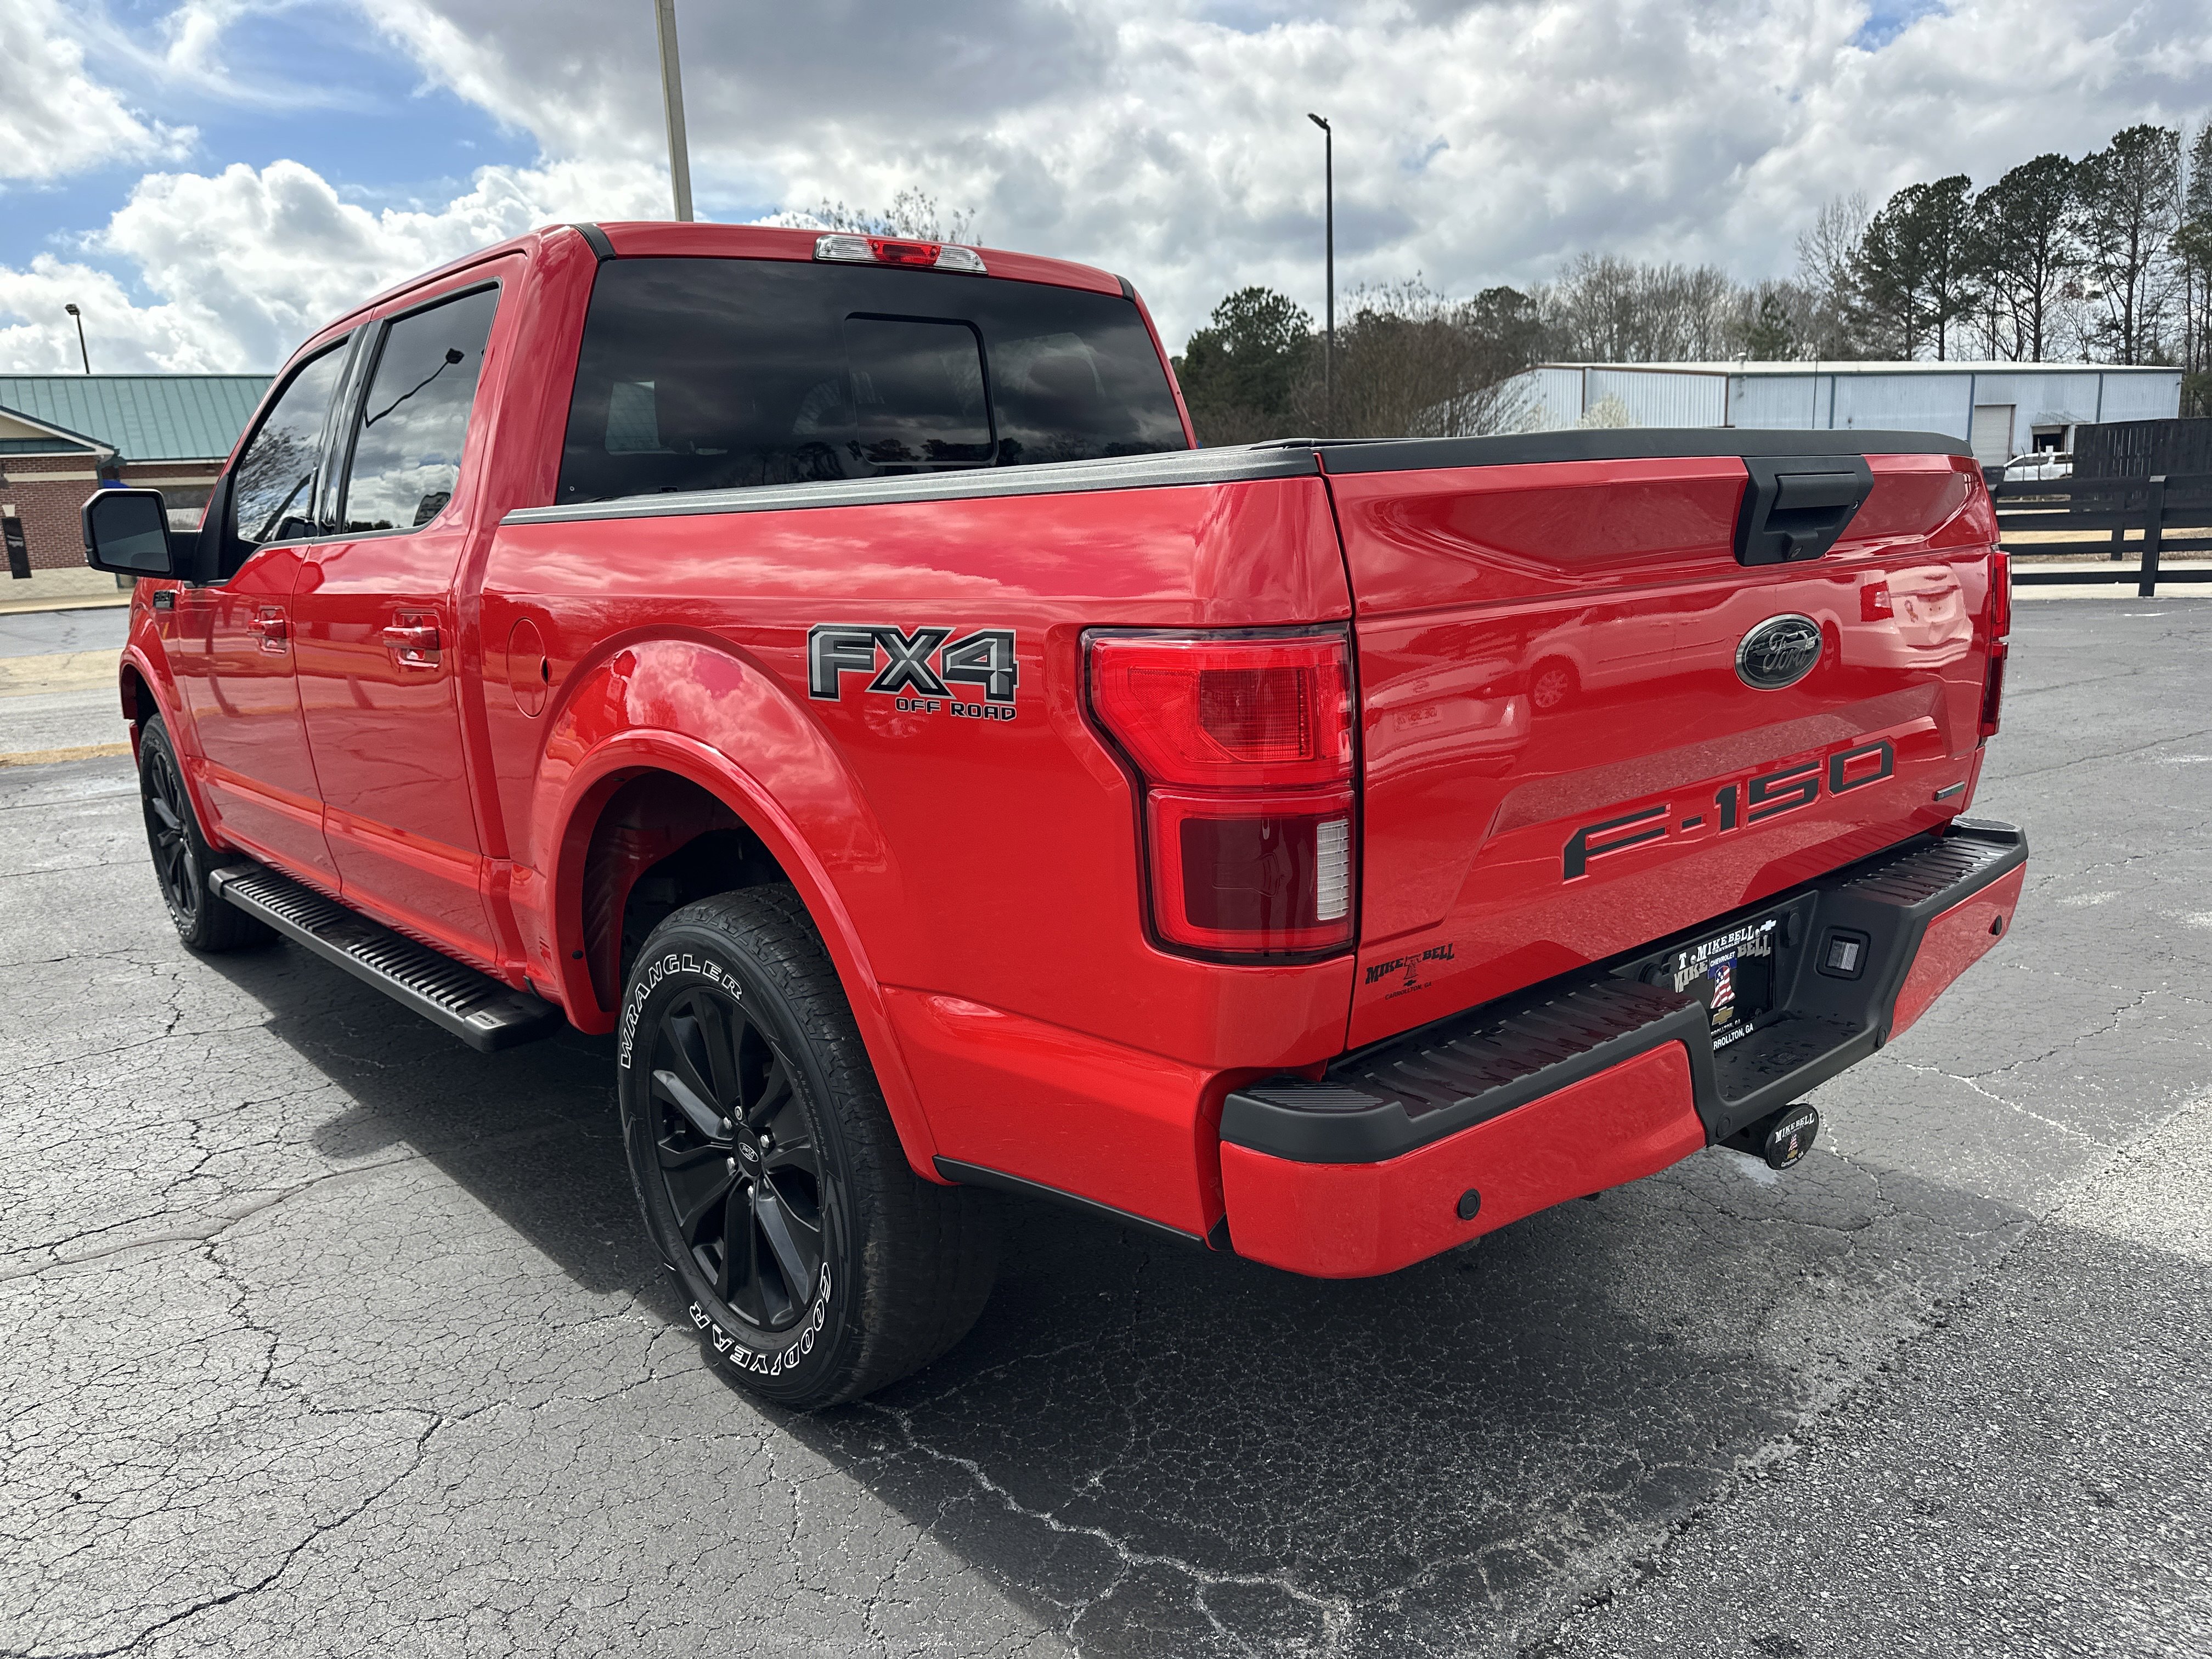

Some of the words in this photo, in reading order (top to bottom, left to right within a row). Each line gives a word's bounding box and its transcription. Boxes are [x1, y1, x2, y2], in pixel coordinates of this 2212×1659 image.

[807, 623, 1019, 704] FX4
[896, 697, 941, 714] OFF
[950, 701, 1017, 721] ROAD
[1562, 737, 1895, 884] F-150
[1365, 958, 1404, 985] MIKE
[1422, 943, 1455, 961] BELL
[1674, 960, 1708, 993] MIKE
[1737, 934, 1771, 958] BELL
[1696, 935, 1727, 962] MIKE
[1728, 925, 1754, 943] BELL
[1710, 951, 1736, 967] CHEVROLET
[620, 953, 743, 1069] WRANGLER
[1713, 1028, 1745, 1050] RROLLTON,
[1745, 1023, 1753, 1034] GA
[1775, 1122, 1796, 1144] MIKE
[1796, 1113, 1815, 1128] BELL
[689, 1262, 831, 1375] GOODYEAR
